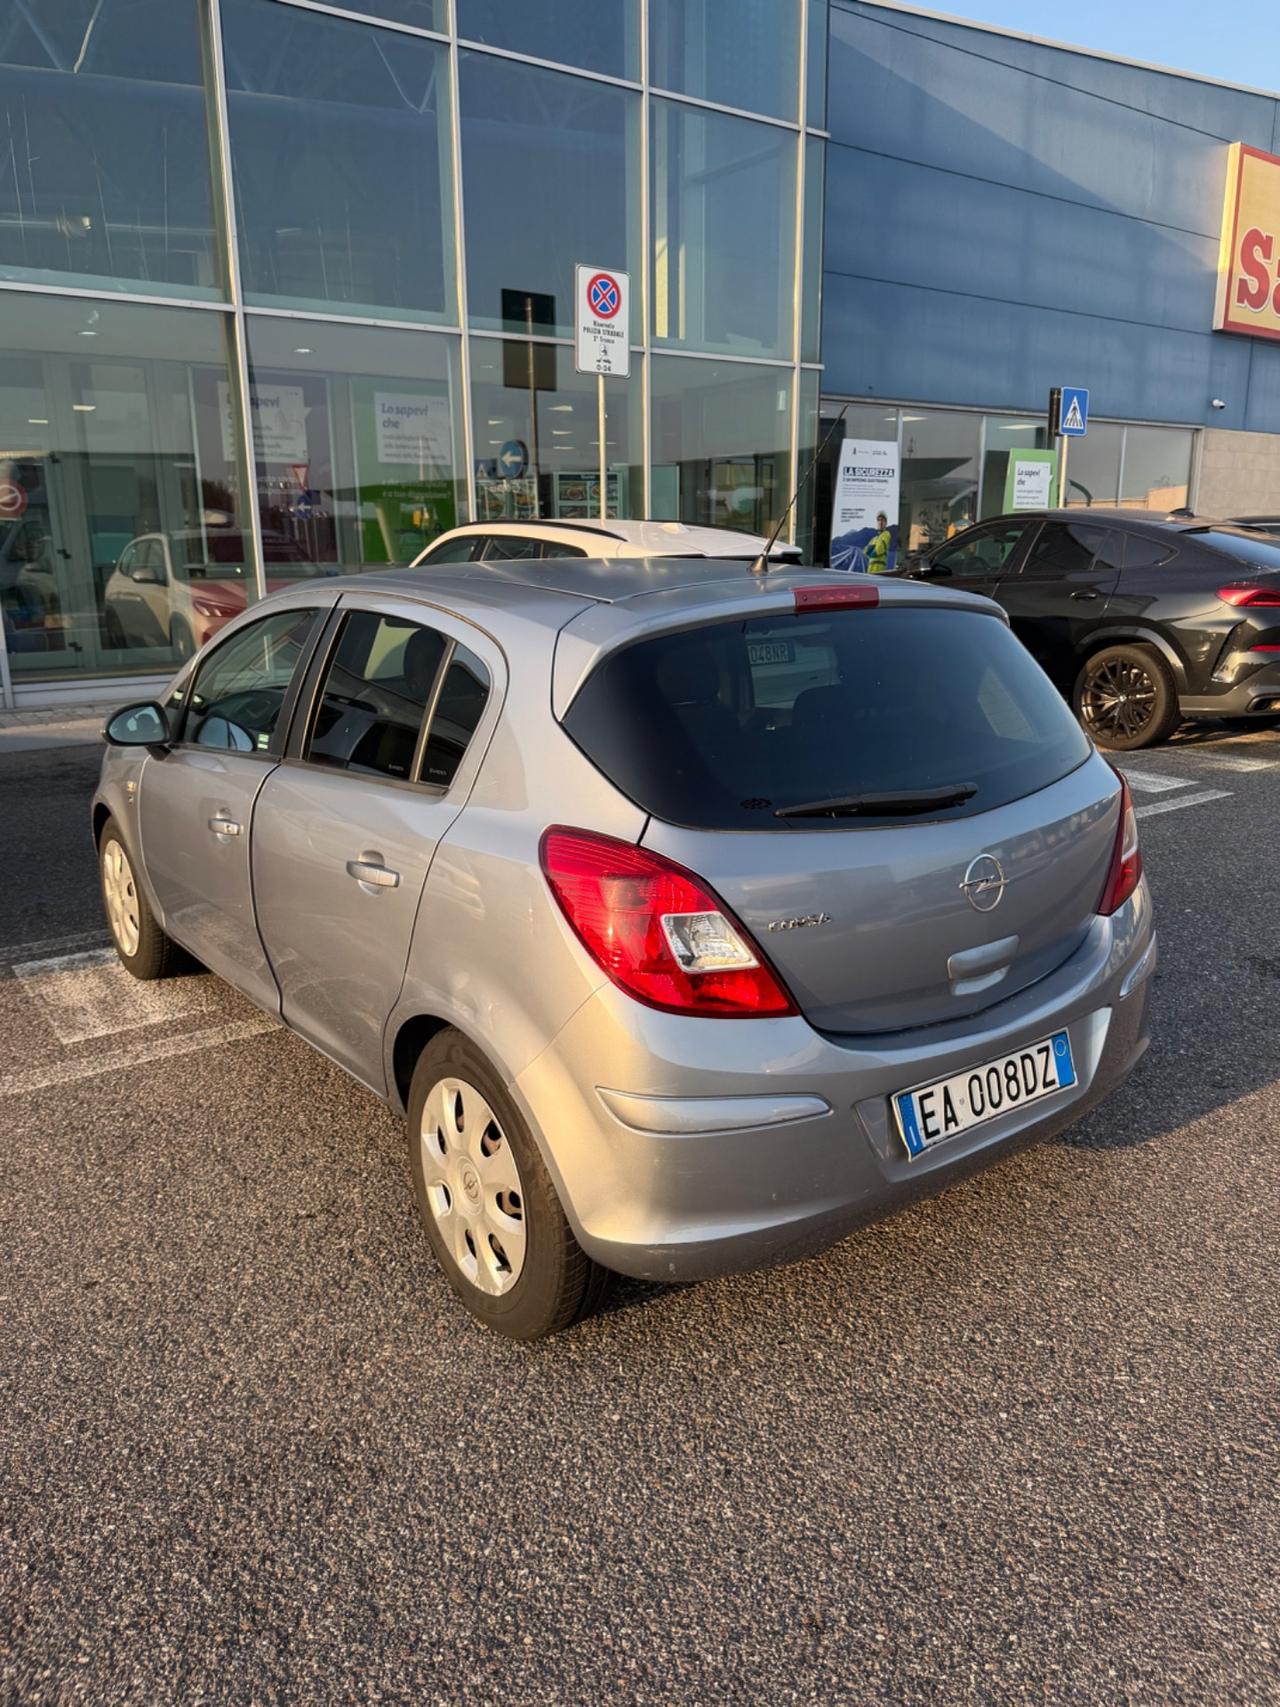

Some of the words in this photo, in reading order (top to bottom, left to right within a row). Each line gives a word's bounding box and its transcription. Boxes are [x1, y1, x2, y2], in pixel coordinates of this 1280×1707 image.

[1237, 228, 1280, 315] S
[583, 327, 601, 335] POLIZIA
[602, 328, 624, 338] STRADALE
[381, 403, 394, 414] Lo
[395, 404, 429, 418] sapevi
[382, 417, 400, 429] che
[843, 467, 855, 476] LA
[856, 467, 895, 478] SICUREZZA
[1017, 467, 1024, 476] Lo
[1024, 469, 1041, 478] sapevi
[1016, 477, 1026, 486] che
[918, 1085, 959, 1140] EA
[967, 1045, 1056, 1117] 008DZ
